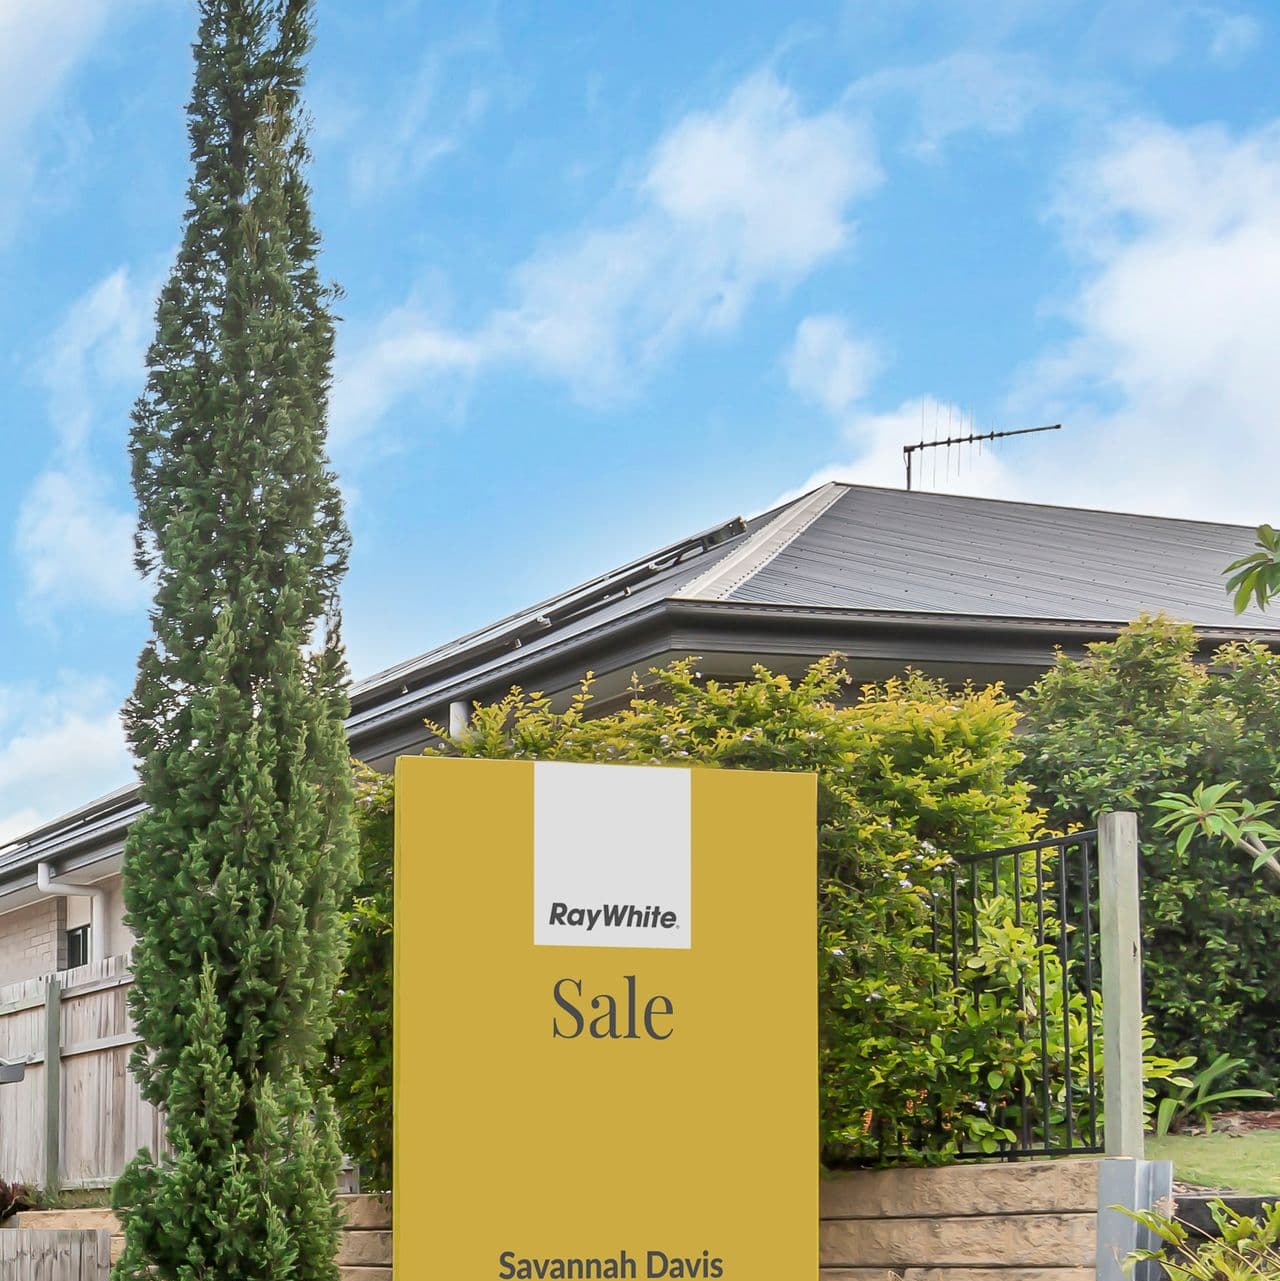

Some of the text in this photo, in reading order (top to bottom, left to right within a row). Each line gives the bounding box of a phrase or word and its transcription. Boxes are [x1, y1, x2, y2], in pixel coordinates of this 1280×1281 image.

[553, 975, 673, 1040] Sale
[499, 1250, 723, 1279] Savannah Davis
